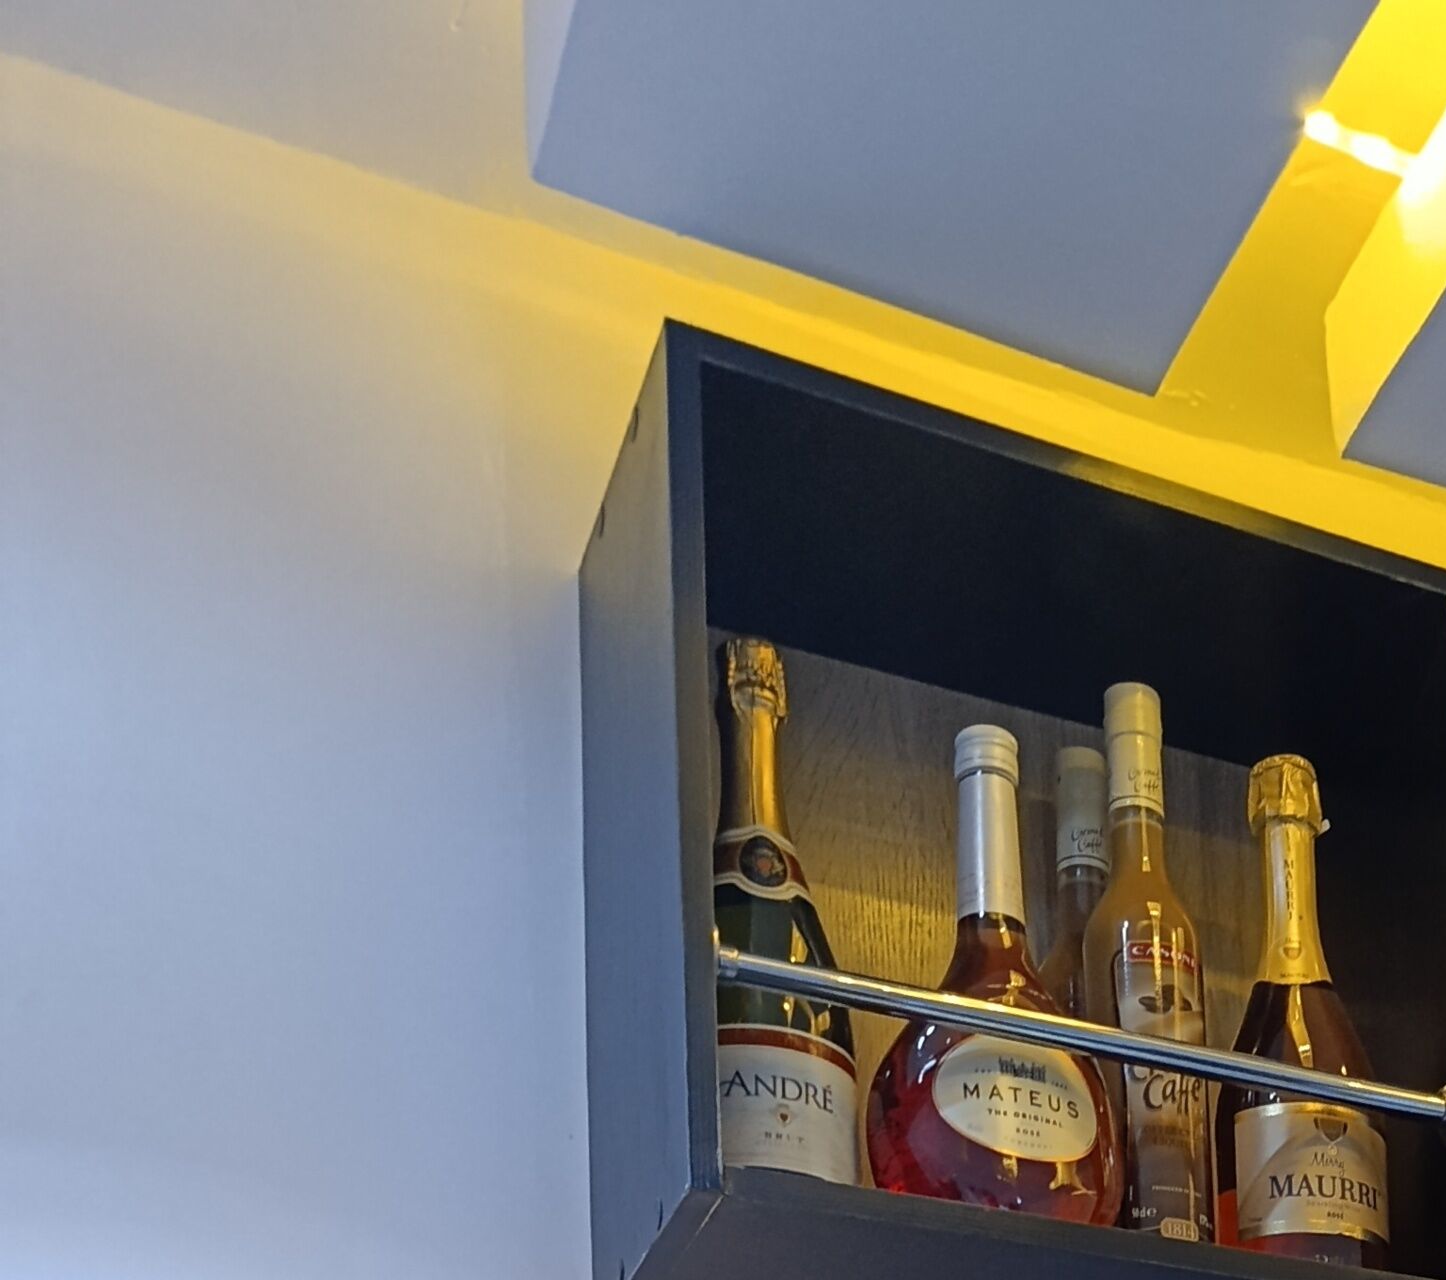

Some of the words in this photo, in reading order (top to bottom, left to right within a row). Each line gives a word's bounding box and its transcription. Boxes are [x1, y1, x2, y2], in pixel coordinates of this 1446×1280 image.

[719, 1070, 833, 1114] ANDRÉ
[962, 1081, 1081, 1120] MATEUS
[1013, 1112, 1064, 1129] ORIGINAL
[1268, 1174, 1379, 1211] MAURRI
